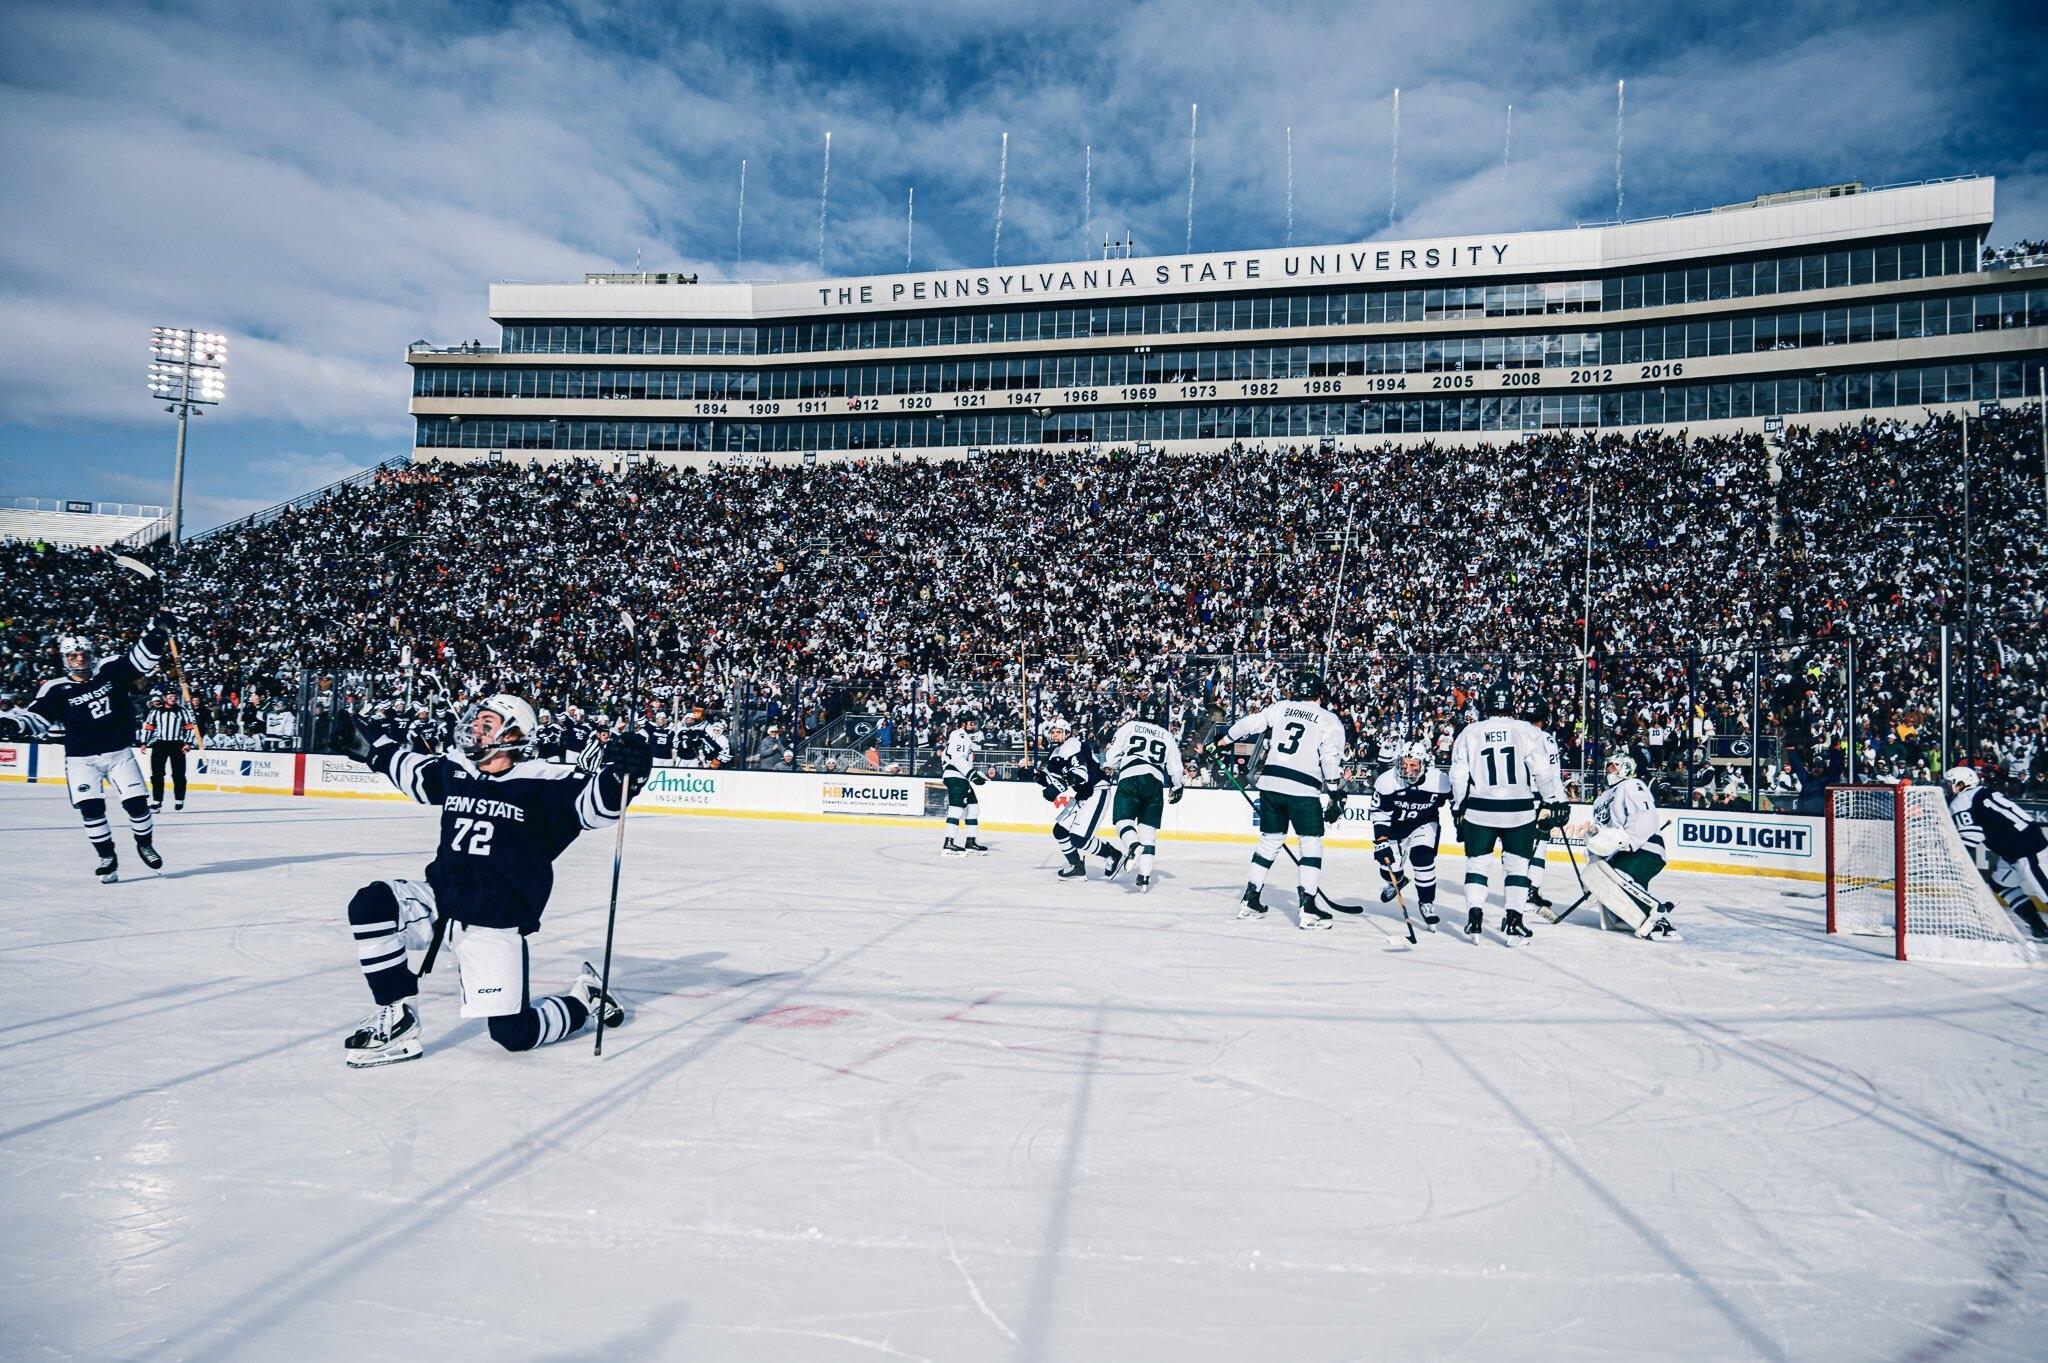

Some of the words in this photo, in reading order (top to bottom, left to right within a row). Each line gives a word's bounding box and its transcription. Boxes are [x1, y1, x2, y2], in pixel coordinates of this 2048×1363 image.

[819, 286, 873, 306] THE
[892, 268, 1136, 301] PENNSYLVANIA
[1156, 259, 1260, 284] STATE
[1285, 244, 1509, 276] UNIVERSITY
[695, 403, 728, 415] 1894
[749, 403, 780, 415] 1909
[797, 401, 828, 413] 1911
[900, 397, 932, 409] 1920
[953, 395, 986, 407] 1921
[1007, 392, 1041, 405] 1947
[1063, 390, 1099, 402] 1968
[1121, 388, 1157, 400] 1969
[1180, 385, 1217, 398] 1973
[1241, 383, 1279, 395] 1982
[1303, 381, 1342, 393] 1986
[1366, 378, 1406, 391] 1994
[1432, 375, 1474, 389] 2005
[1502, 372, 1540, 386] 2008
[1571, 369, 1613, 384] 2012
[1641, 363, 1683, 379] 2016
[68, 691, 94, 706] PENN
[88, 696, 112, 719] 27
[1284, 708, 1320, 724] BARNHILL
[956, 744, 965, 752] 21
[1277, 721, 1306, 755] 3
[1484, 731, 1507, 743] WEST
[1127, 735, 1167, 764] 29
[1480, 746, 1517, 786] 11
[647, 770, 715, 793] Amica
[444, 795, 476, 813] PENN
[475, 798, 525, 822] STATE
[656, 794, 709, 804] INSURANCE
[1410, 802, 1433, 810] STAT
[1430, 793, 1438, 803] C
[451, 817, 495, 856] 72
[1682, 823, 1733, 844] BUD
[1736, 827, 1807, 850] LIGHT
